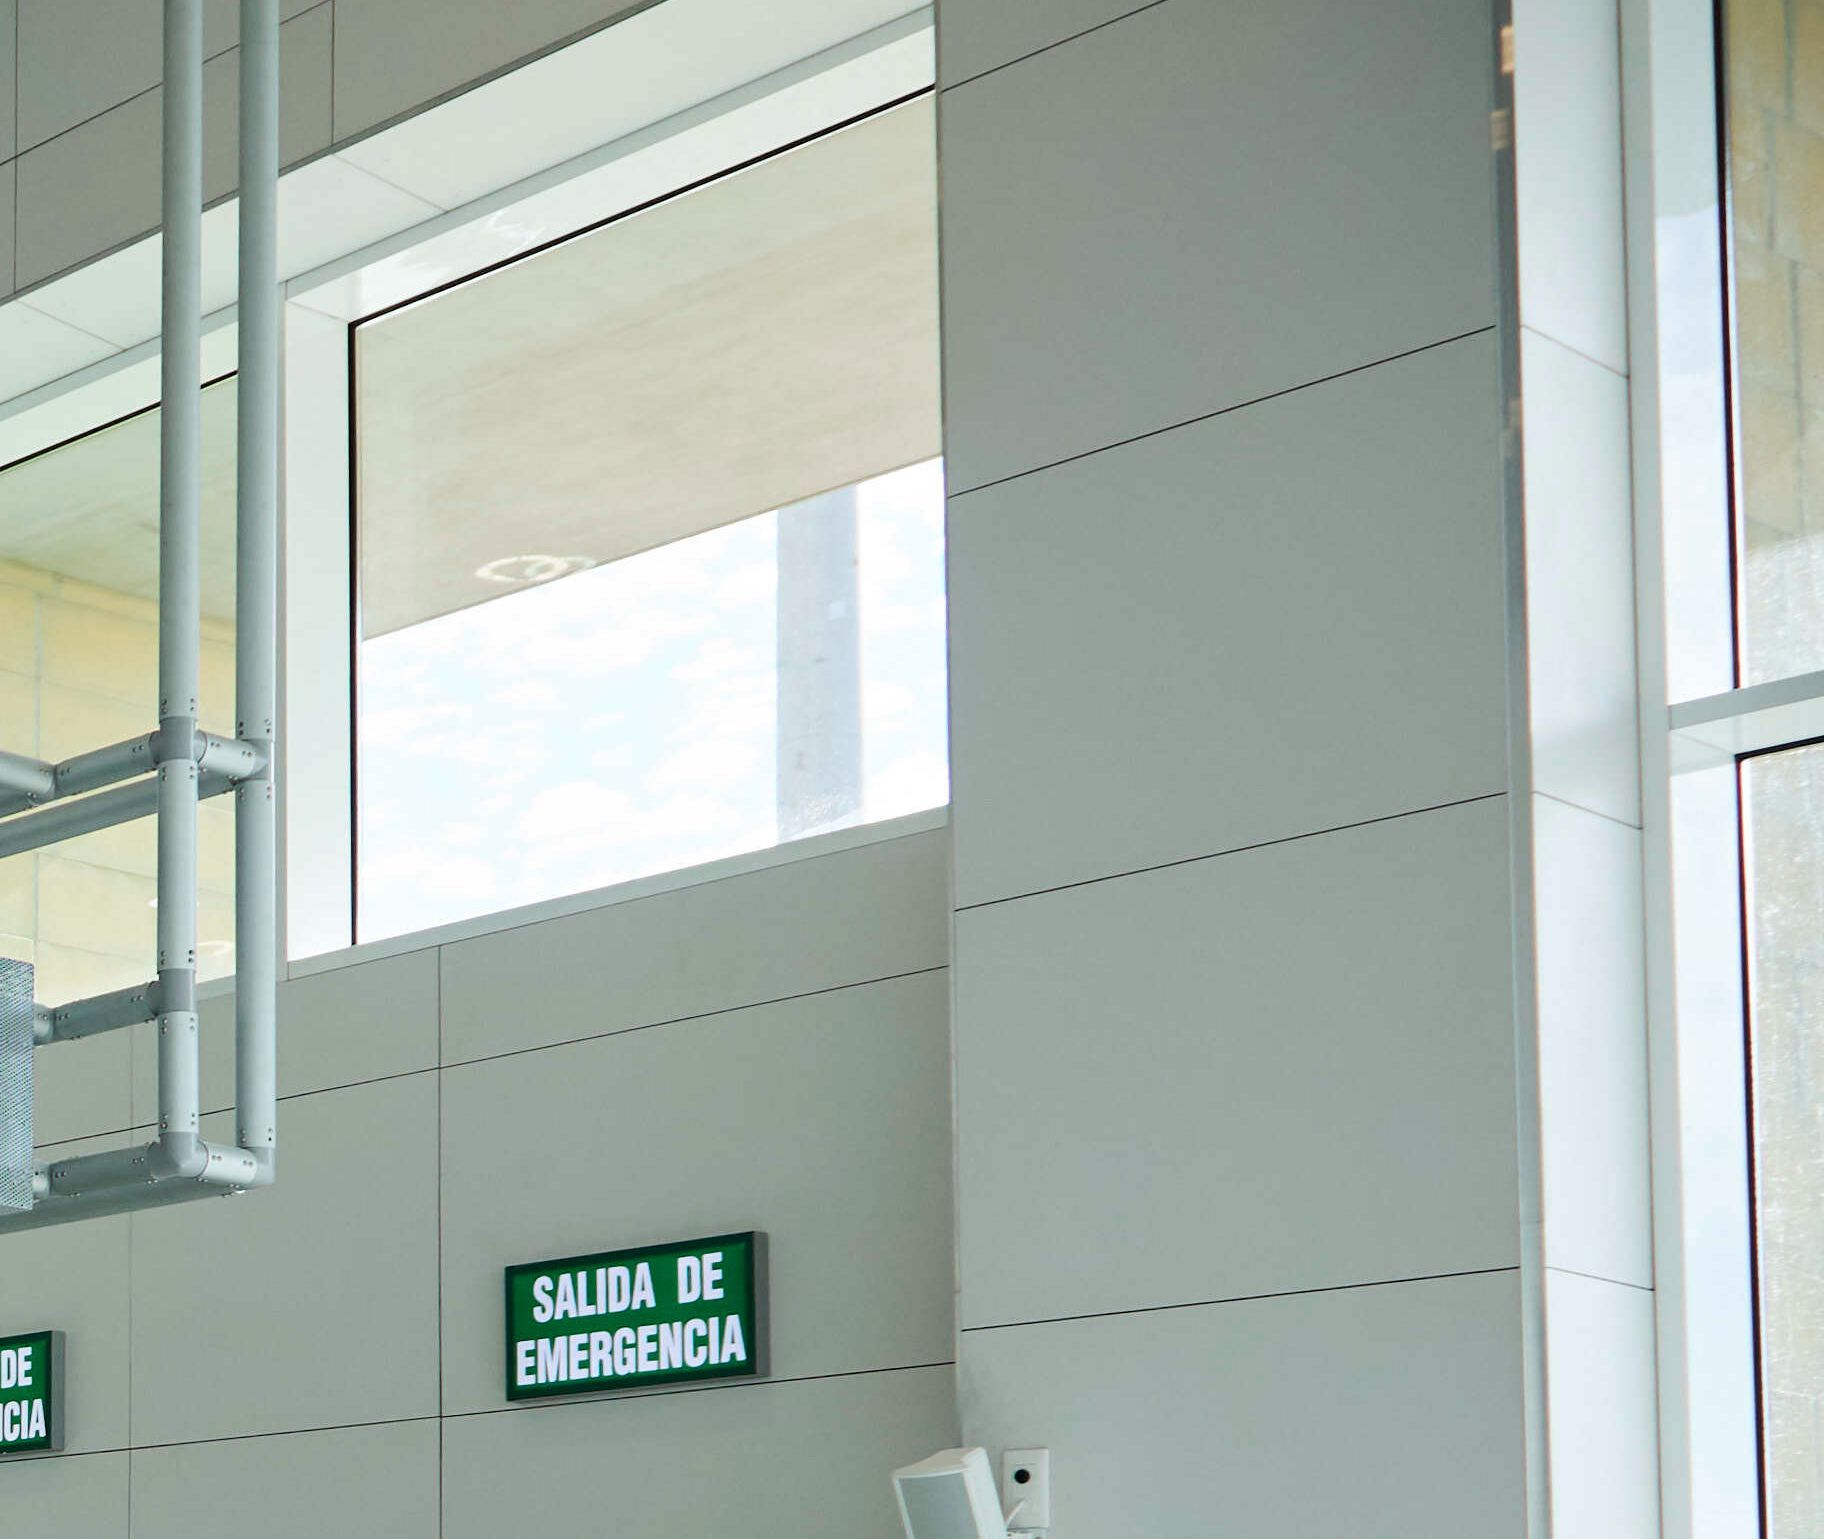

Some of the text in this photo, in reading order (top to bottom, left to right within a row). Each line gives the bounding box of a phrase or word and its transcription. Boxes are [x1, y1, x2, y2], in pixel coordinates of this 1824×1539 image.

[532, 1252, 724, 1323] SALIDA DE
[1, 1347, 33, 1389] DE
[516, 1314, 747, 1386] EMERGENCIA
